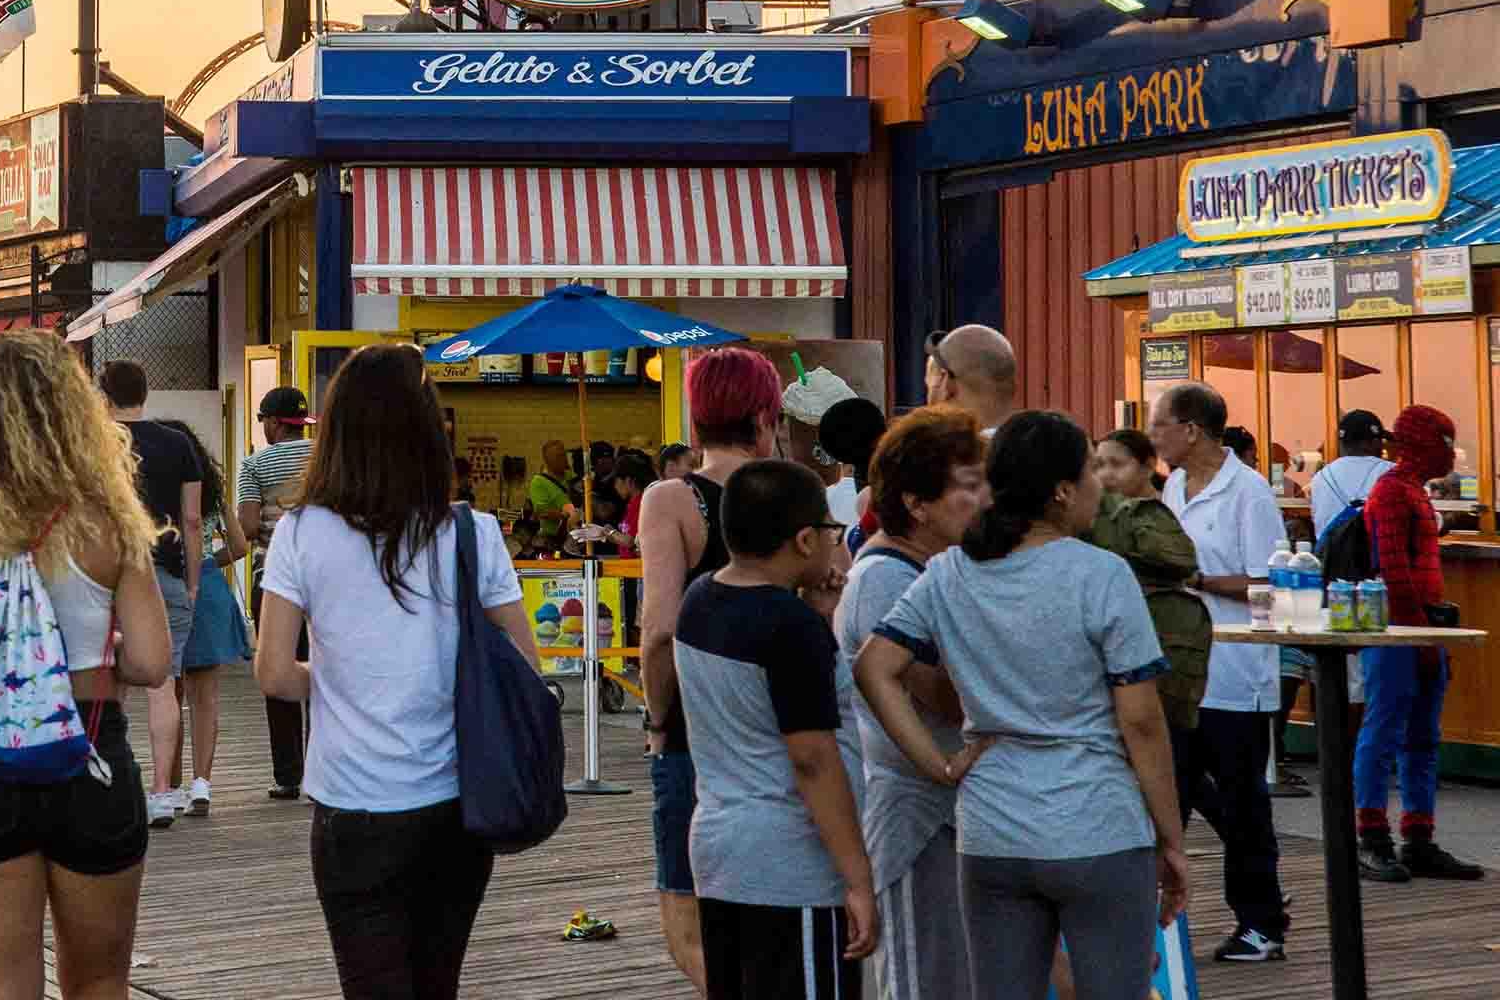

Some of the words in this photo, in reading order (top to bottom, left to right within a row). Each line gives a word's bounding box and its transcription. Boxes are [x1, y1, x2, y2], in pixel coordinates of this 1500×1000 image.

[412, 51, 561, 93] Gelato
[566, 57, 594, 84] &
[600, 50, 756, 86] Sorbet
[1023, 81, 1106, 155] LUNA
[1118, 64, 1210, 142] PARK
[1189, 172, 1248, 225] LUNA
[1254, 162, 1319, 221] PARK
[1323, 148, 1427, 209] TICKETS
[1246, 290, 1281, 314] $42.00
[1294, 287, 1332, 313] $69.00
